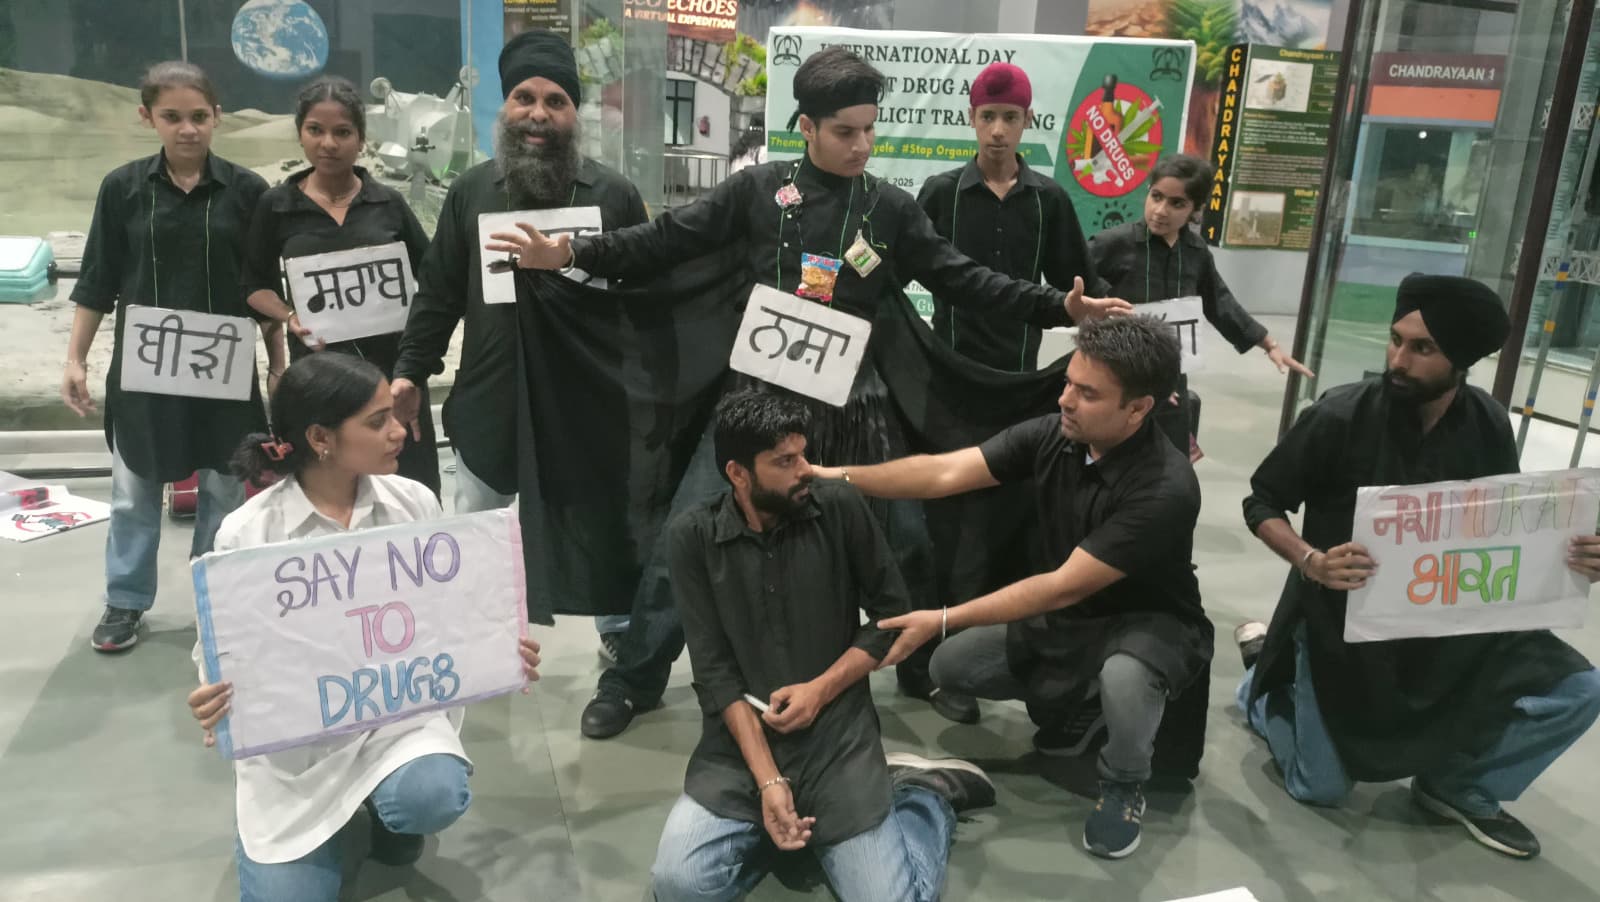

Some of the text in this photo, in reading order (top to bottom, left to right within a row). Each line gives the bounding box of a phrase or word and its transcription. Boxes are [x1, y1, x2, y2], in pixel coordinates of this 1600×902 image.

[635, 9, 676, 22] VIRTUAL
[677, 14, 736, 29] EXPEDITION
[977, 48, 1016, 66] DAY
[1389, 64, 1485, 81] CHANDRAYAAN
[902, 77, 954, 96] DRUG
[1086, 104, 1135, 182] NO DRUGS
[1207, 47, 1242, 240] CHANDRAYAAN 1
[303, 257, 408, 314] ਸ਼ਰਾਬ
[748, 305, 852, 374] ਨਸ਼ਾ
[273, 531, 461, 618] SAY NO
[344, 601, 416, 658] TO
[316, 652, 461, 729] DRUGS
